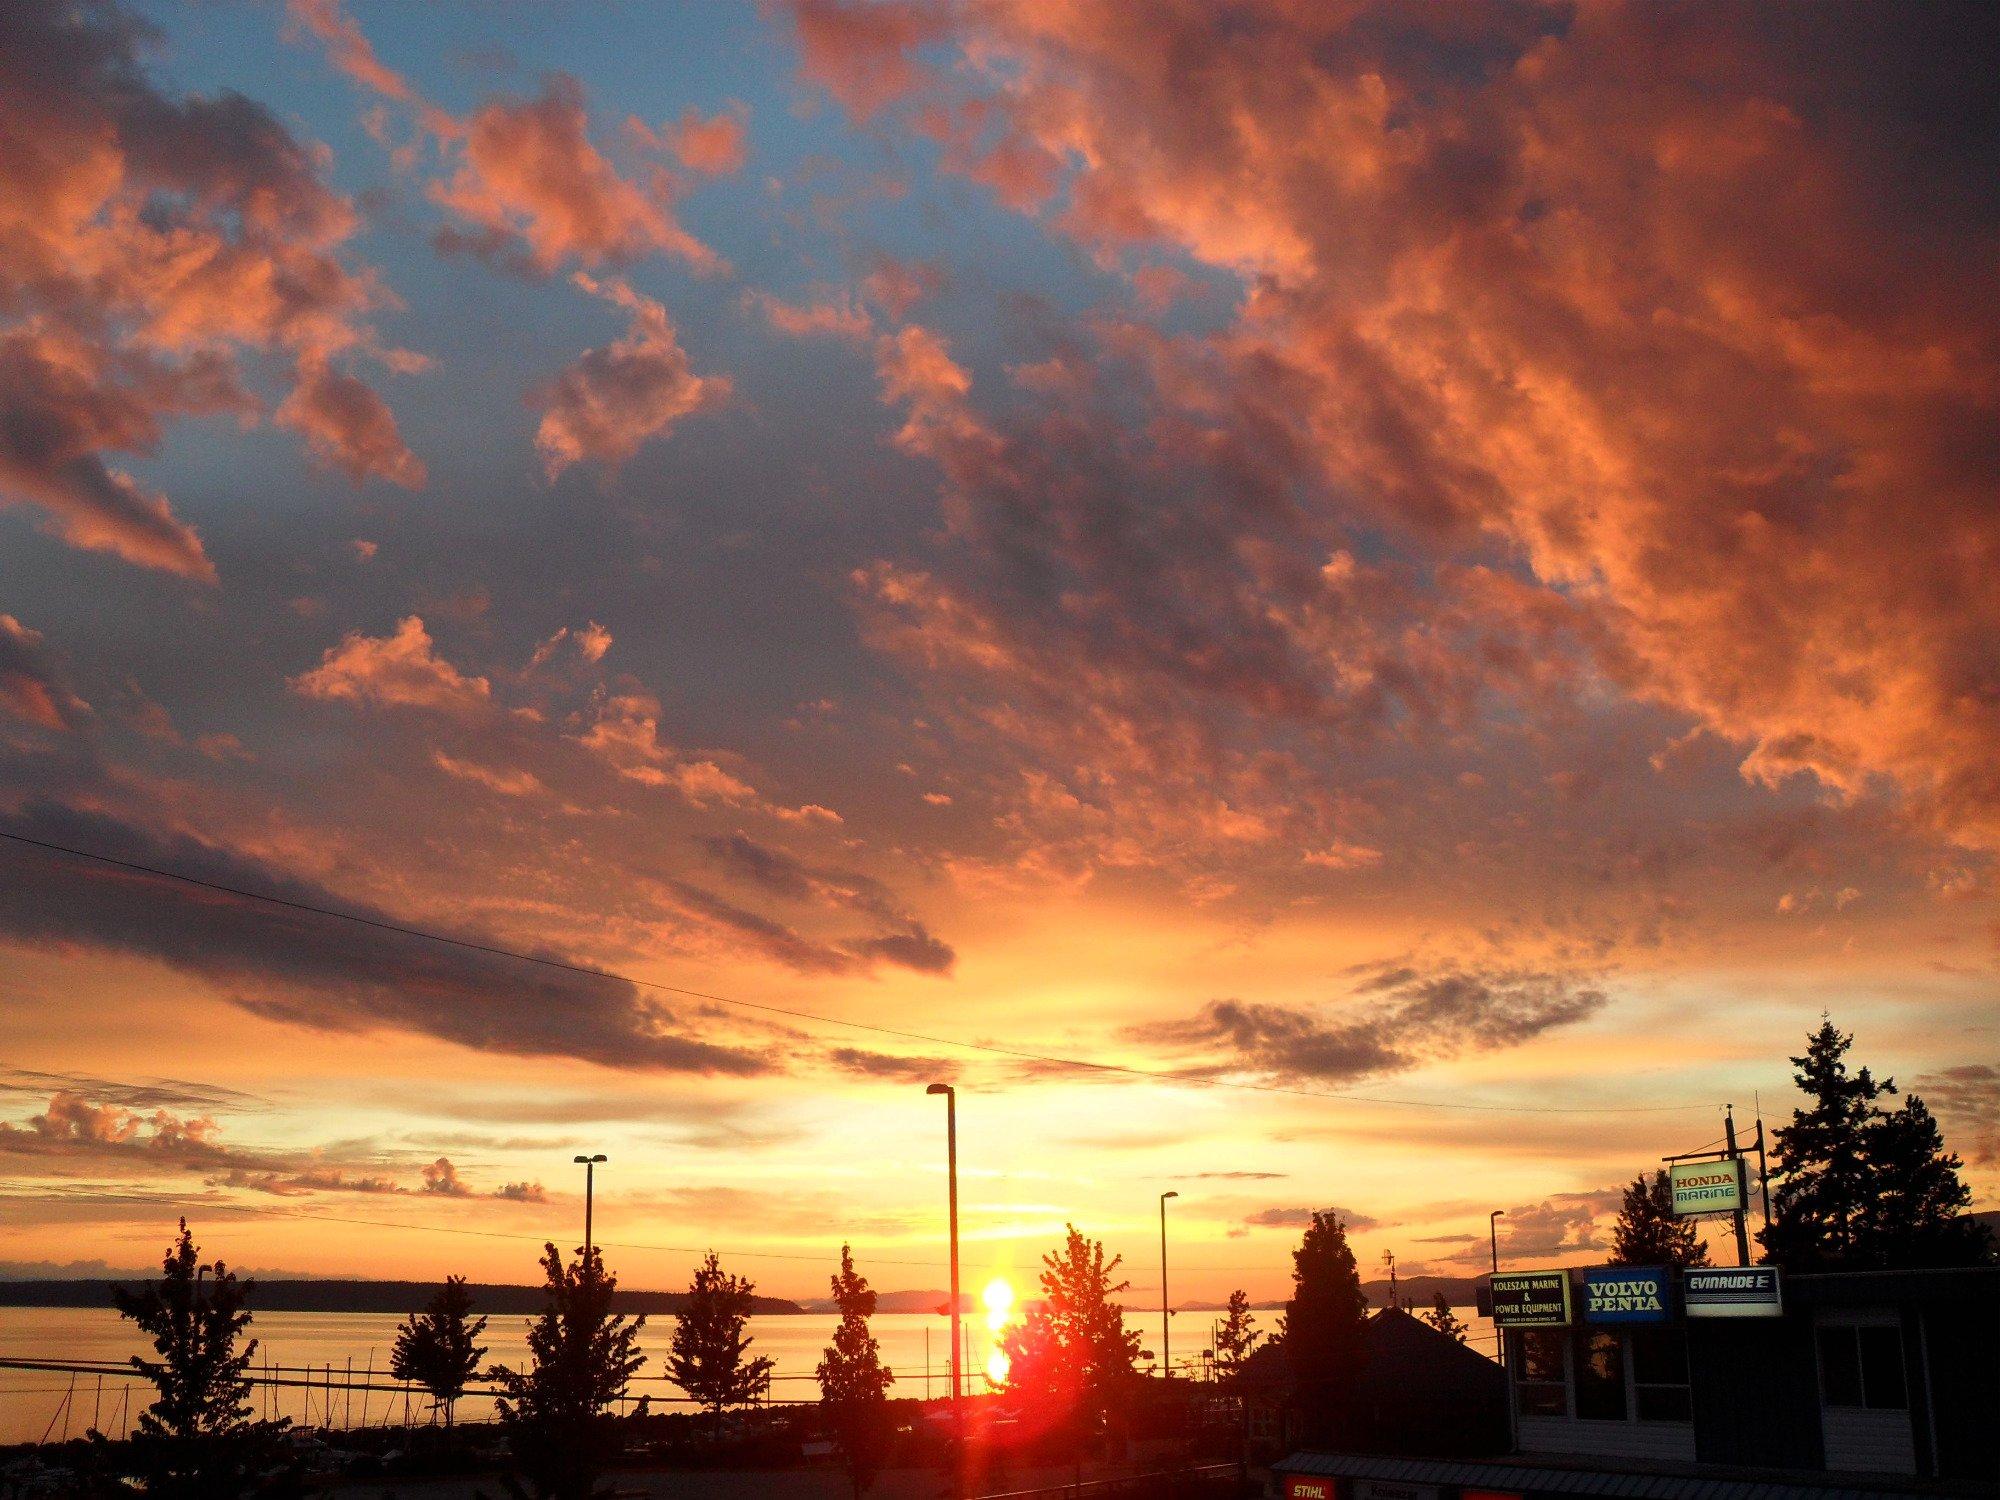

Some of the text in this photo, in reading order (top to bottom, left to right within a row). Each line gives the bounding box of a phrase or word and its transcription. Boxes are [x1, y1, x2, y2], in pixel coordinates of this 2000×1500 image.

[1675, 1173, 1735, 1188] HONDA
[1494, 1279, 1560, 1291] KOLESZAR MARINE
[1588, 1281, 1658, 1297] VOLVO
[1690, 1275, 1755, 1289] EVINRUDE
[1524, 1292, 1531, 1301] &
[1495, 1303, 1562, 1314] POWER EQUIPMENT
[1589, 1296, 1663, 1312] PENTA
[1293, 1484, 1326, 1499] STIHL
